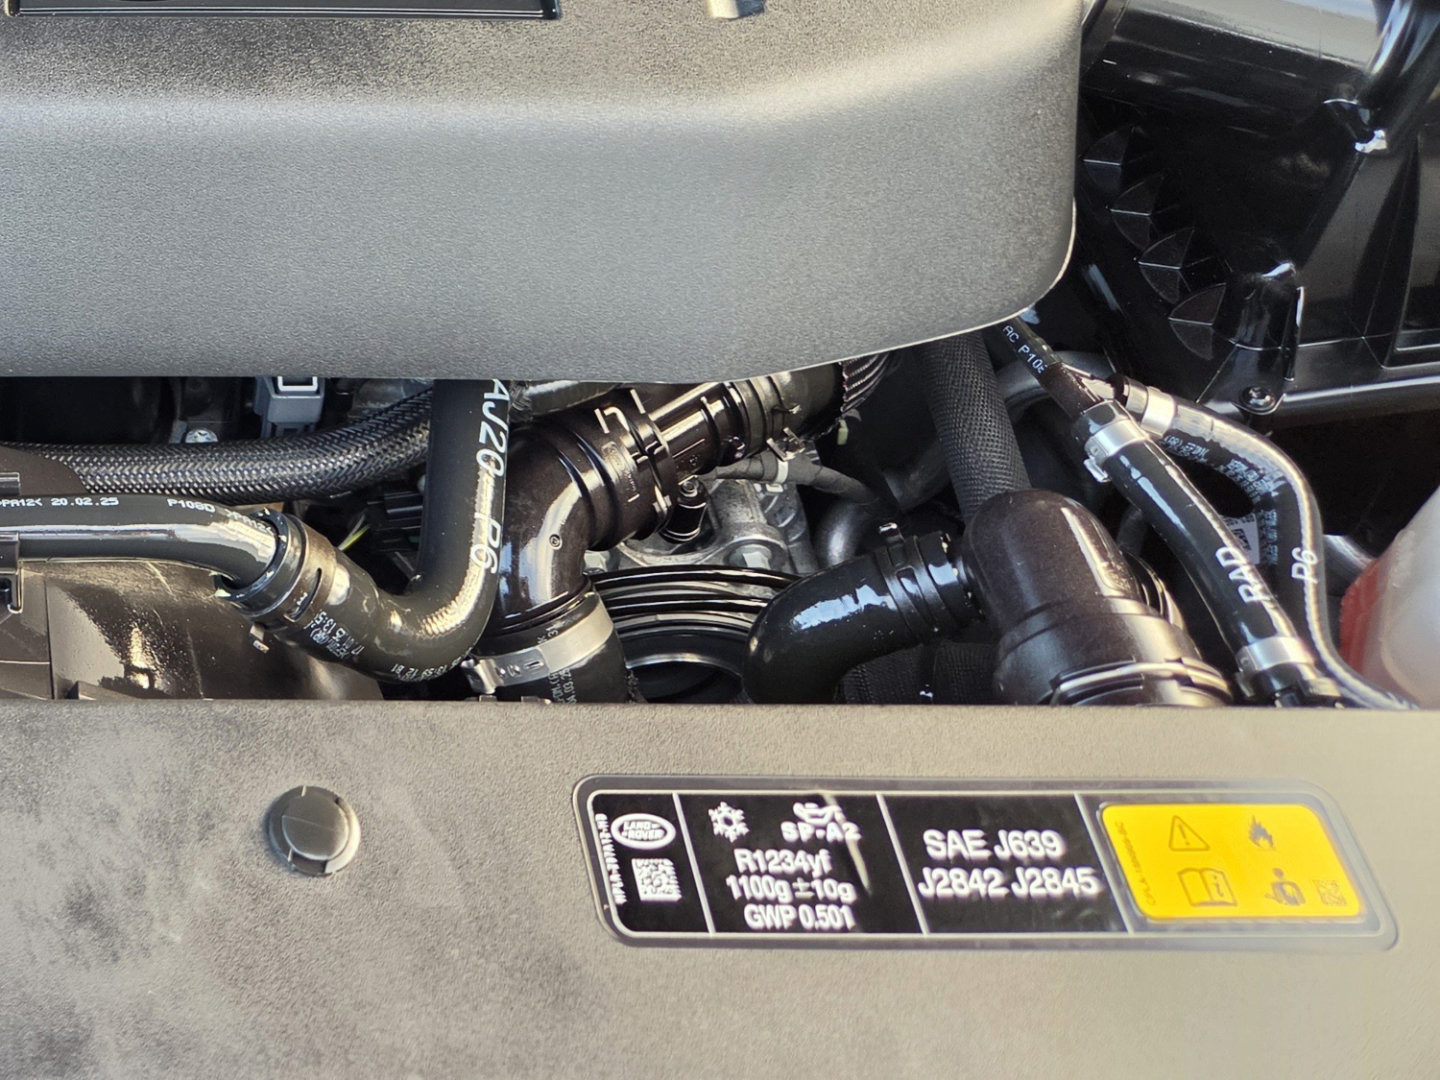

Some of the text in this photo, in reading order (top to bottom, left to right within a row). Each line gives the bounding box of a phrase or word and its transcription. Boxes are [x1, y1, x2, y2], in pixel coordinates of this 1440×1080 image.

[470, 378, 510, 574] AJ20 P6
[50, 497, 120, 506] 20.02.25
[166, 498, 216, 513] P108D
[1215, 546, 1271, 604] RAD
[1291, 547, 1318, 584] P6
[780, 821, 863, 842] SP-A2
[923, 829, 1068, 860] SAE J639
[733, 848, 833, 879] R1234yf
[917, 866, 1105, 899] J2842 J2845
[743, 903, 857, 931] GWP 0.501
